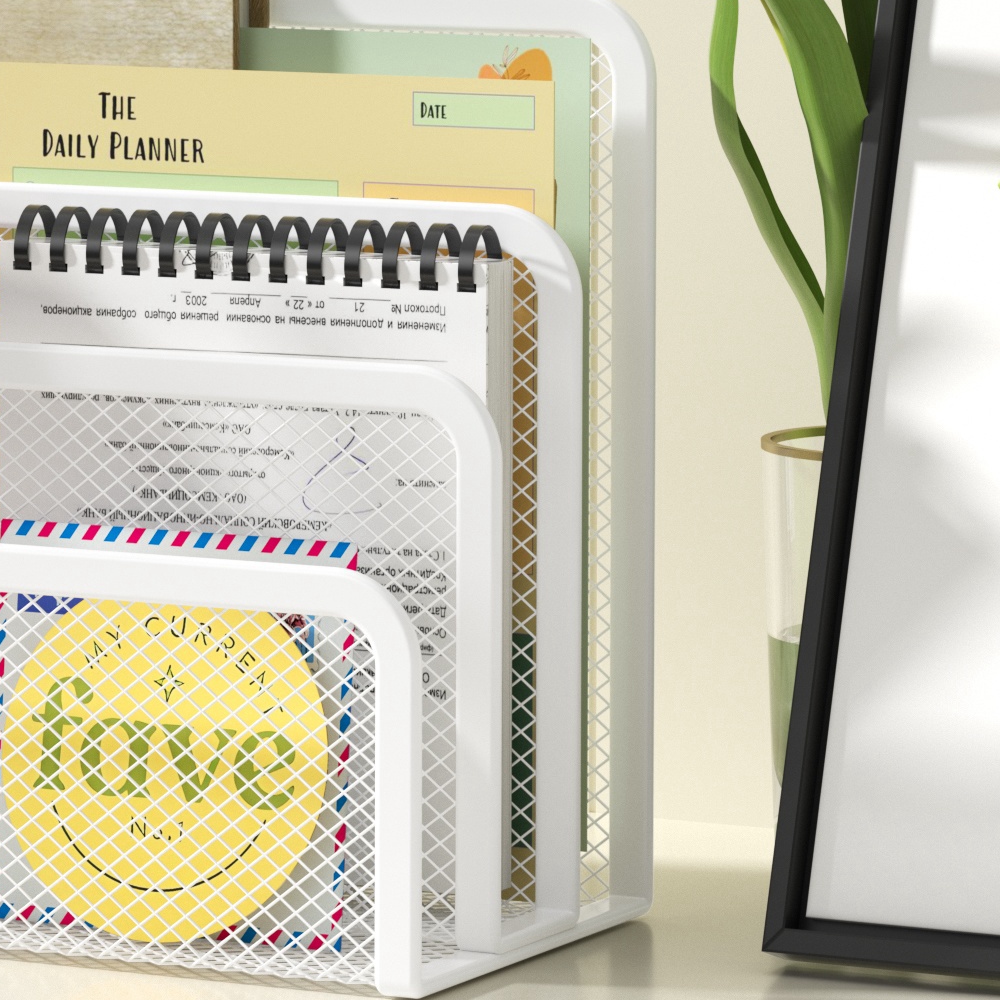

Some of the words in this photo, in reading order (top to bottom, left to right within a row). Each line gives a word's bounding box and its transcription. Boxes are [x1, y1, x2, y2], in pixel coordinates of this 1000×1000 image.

[98, 91, 137, 120] THE
[420, 101, 447, 119] DATE
[42, 128, 99, 158] DAILY
[110, 131, 205, 163] PLANNER
[185, 294, 208, 307] 2003
[229, 294, 262, 308] Апреля
[315, 300, 326, 310] от
[40, 303, 93, 317] акционеров,
[95, 306, 137, 321] собрания
[354, 301, 366, 314] 21
[403, 302, 447, 317] Протокол
[143, 308, 177, 323] общего
[180, 310, 220, 322] решения
[225, 313, 272, 325] основании
[274, 315, 286, 325] на
[288, 315, 327, 327] внесены
[329, 317, 385, 329] дополнения
[386, 319, 394, 330] и
[396, 320, 447, 333] Изменения
[84, 623, 122, 669] MY
[32, 675, 297, 811] fave
